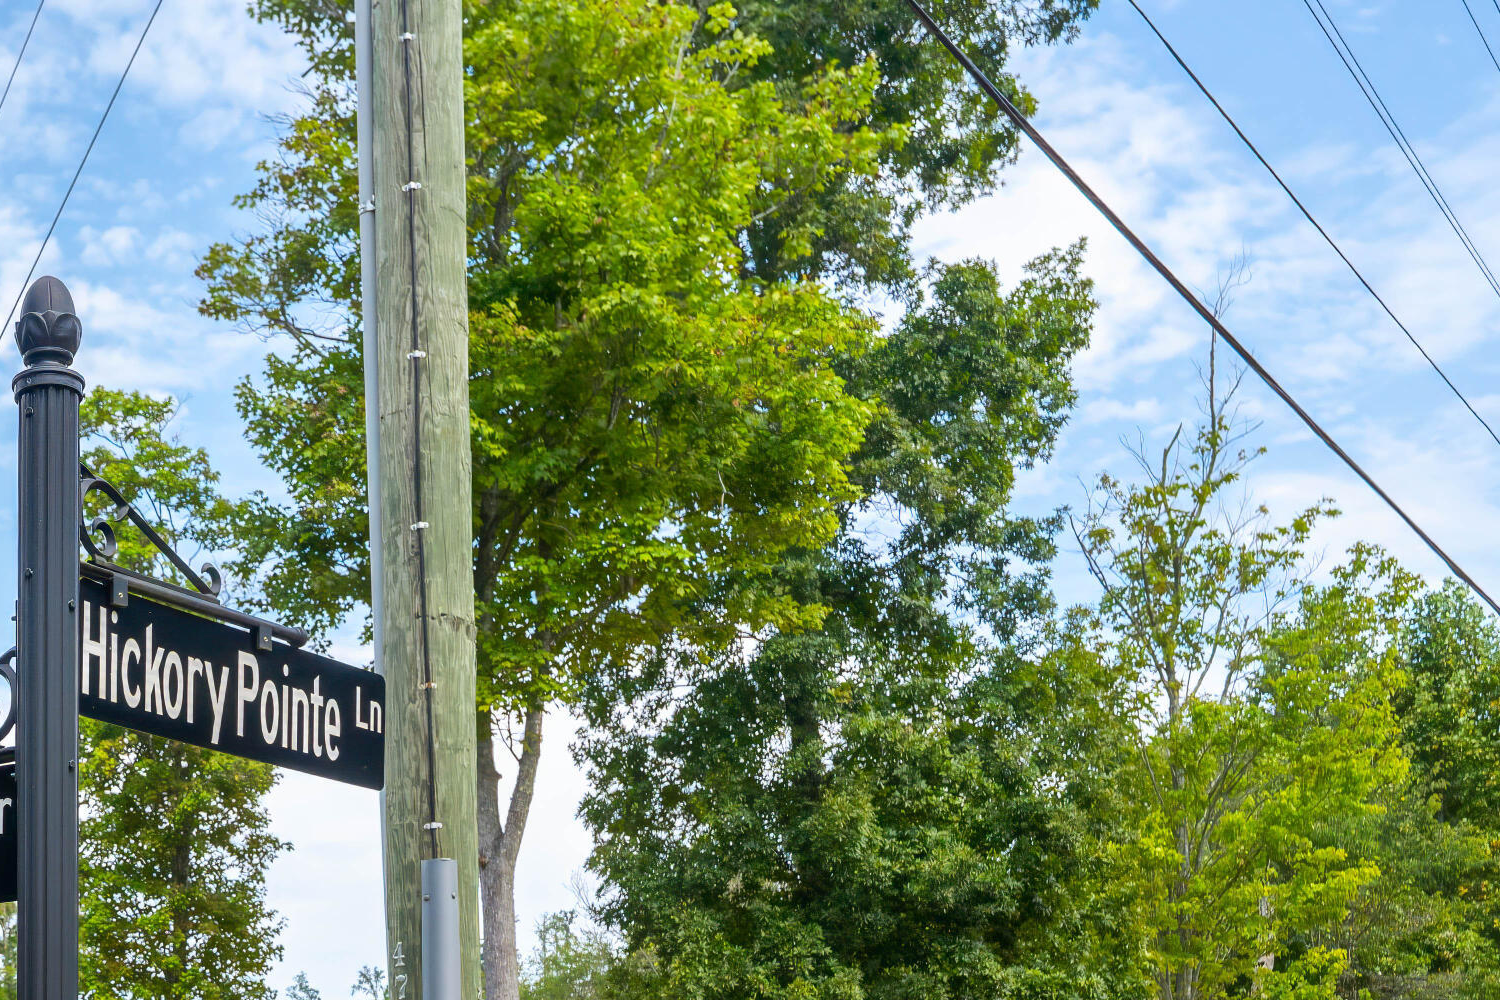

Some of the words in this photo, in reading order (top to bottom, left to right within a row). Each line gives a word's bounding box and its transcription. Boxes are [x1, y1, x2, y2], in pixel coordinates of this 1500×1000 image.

[80, 600, 230, 746] Hickory
[236, 652, 341, 761] Pointe
[355, 686, 382, 734] Ln
